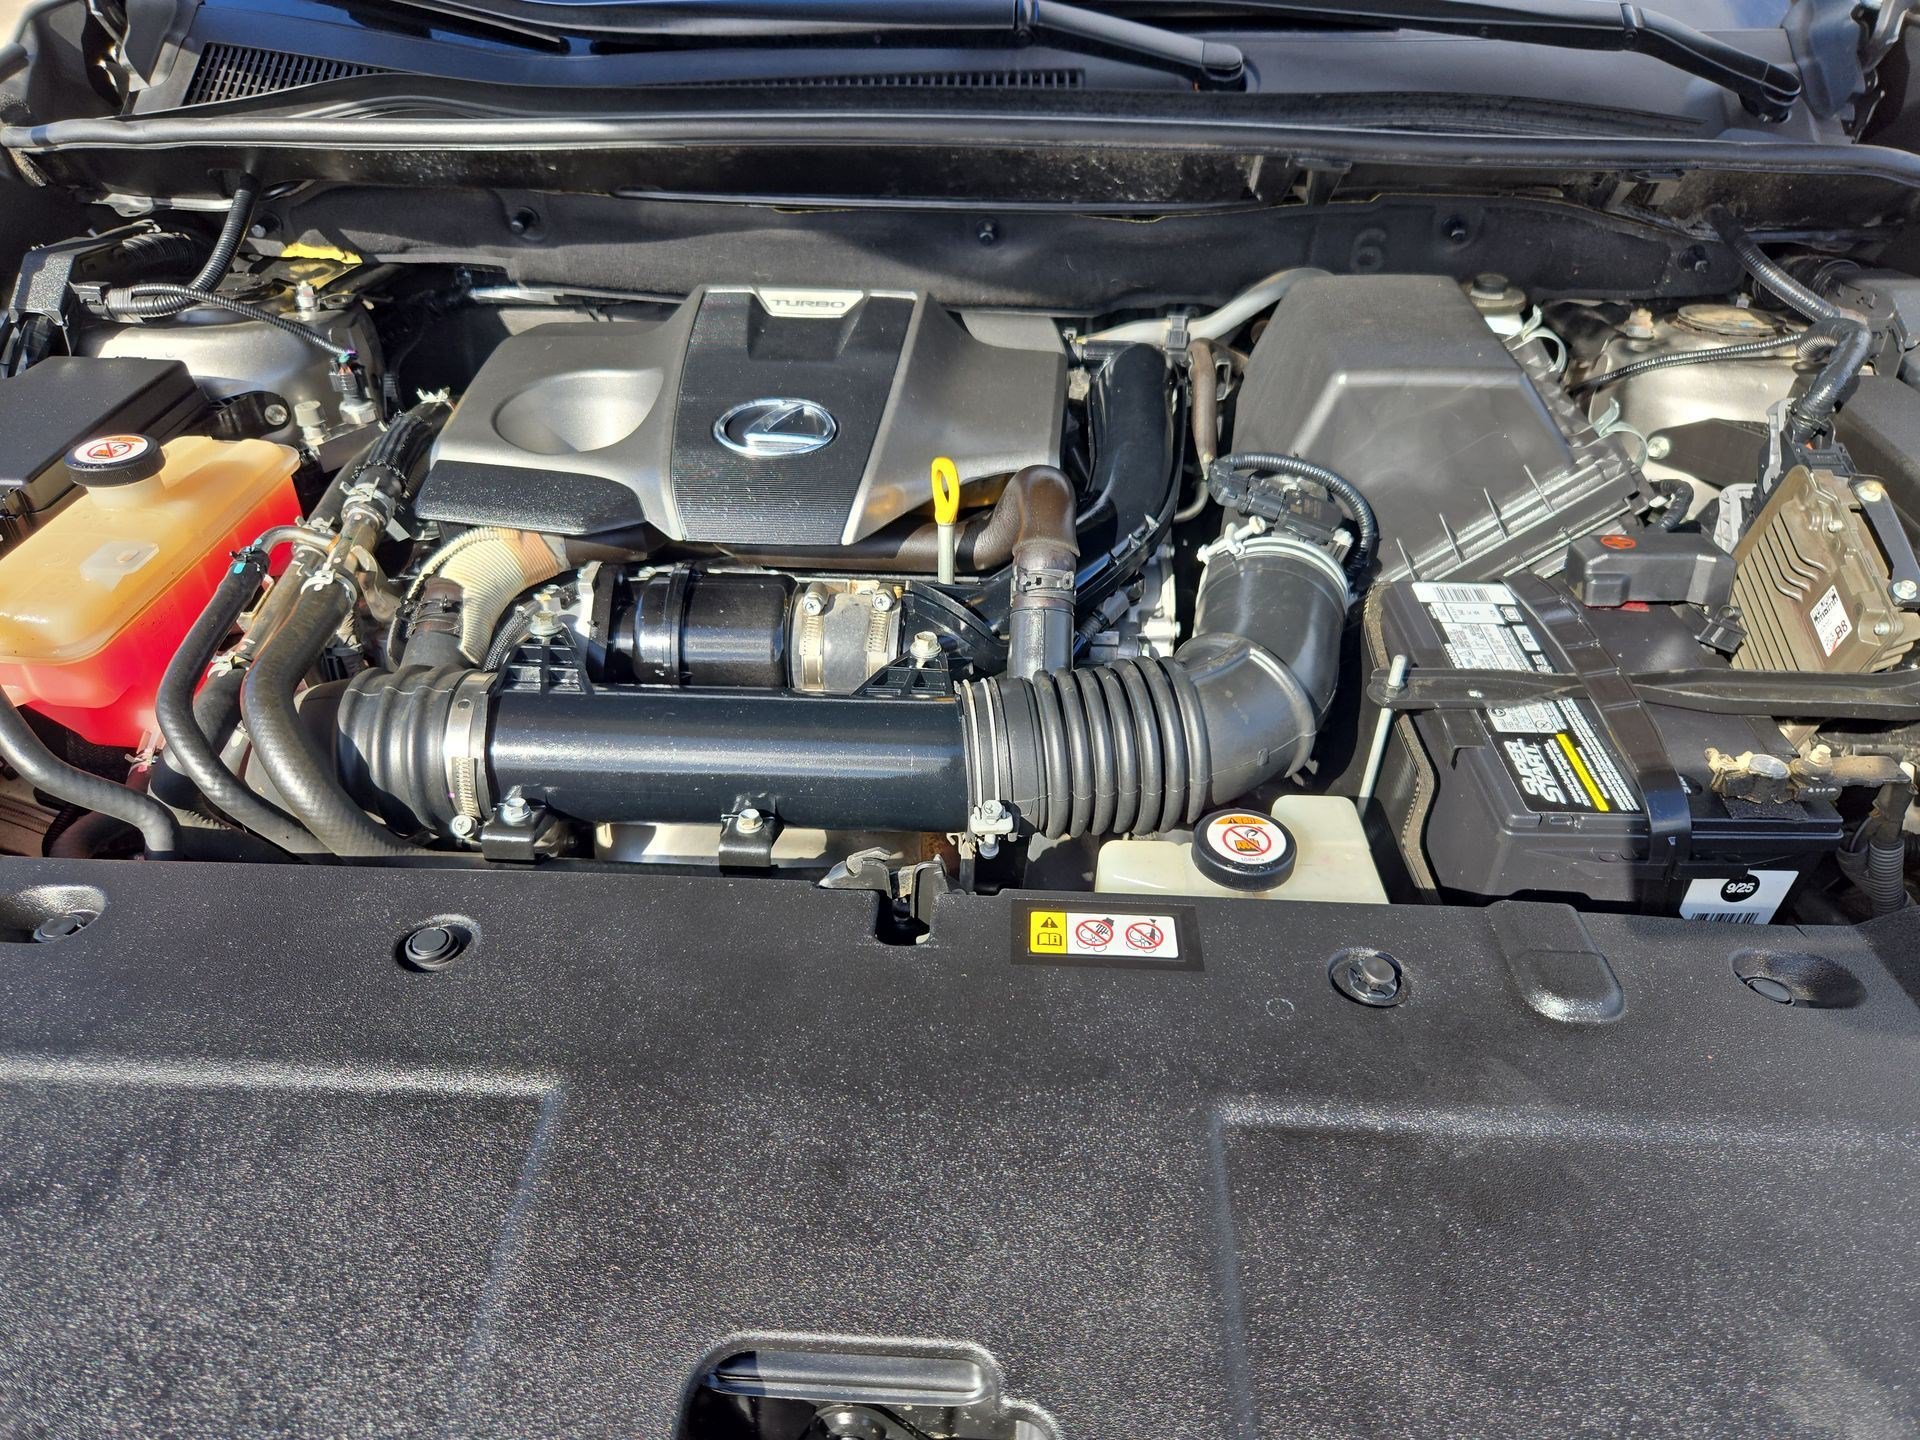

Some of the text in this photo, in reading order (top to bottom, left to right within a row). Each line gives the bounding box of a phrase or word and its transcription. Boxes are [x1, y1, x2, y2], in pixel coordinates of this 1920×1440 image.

[770, 299, 846, 308] TURBO
[1504, 741, 1538, 796] SUPER
[1517, 739, 1560, 803] START
[1725, 882, 1755, 894] 9/25
